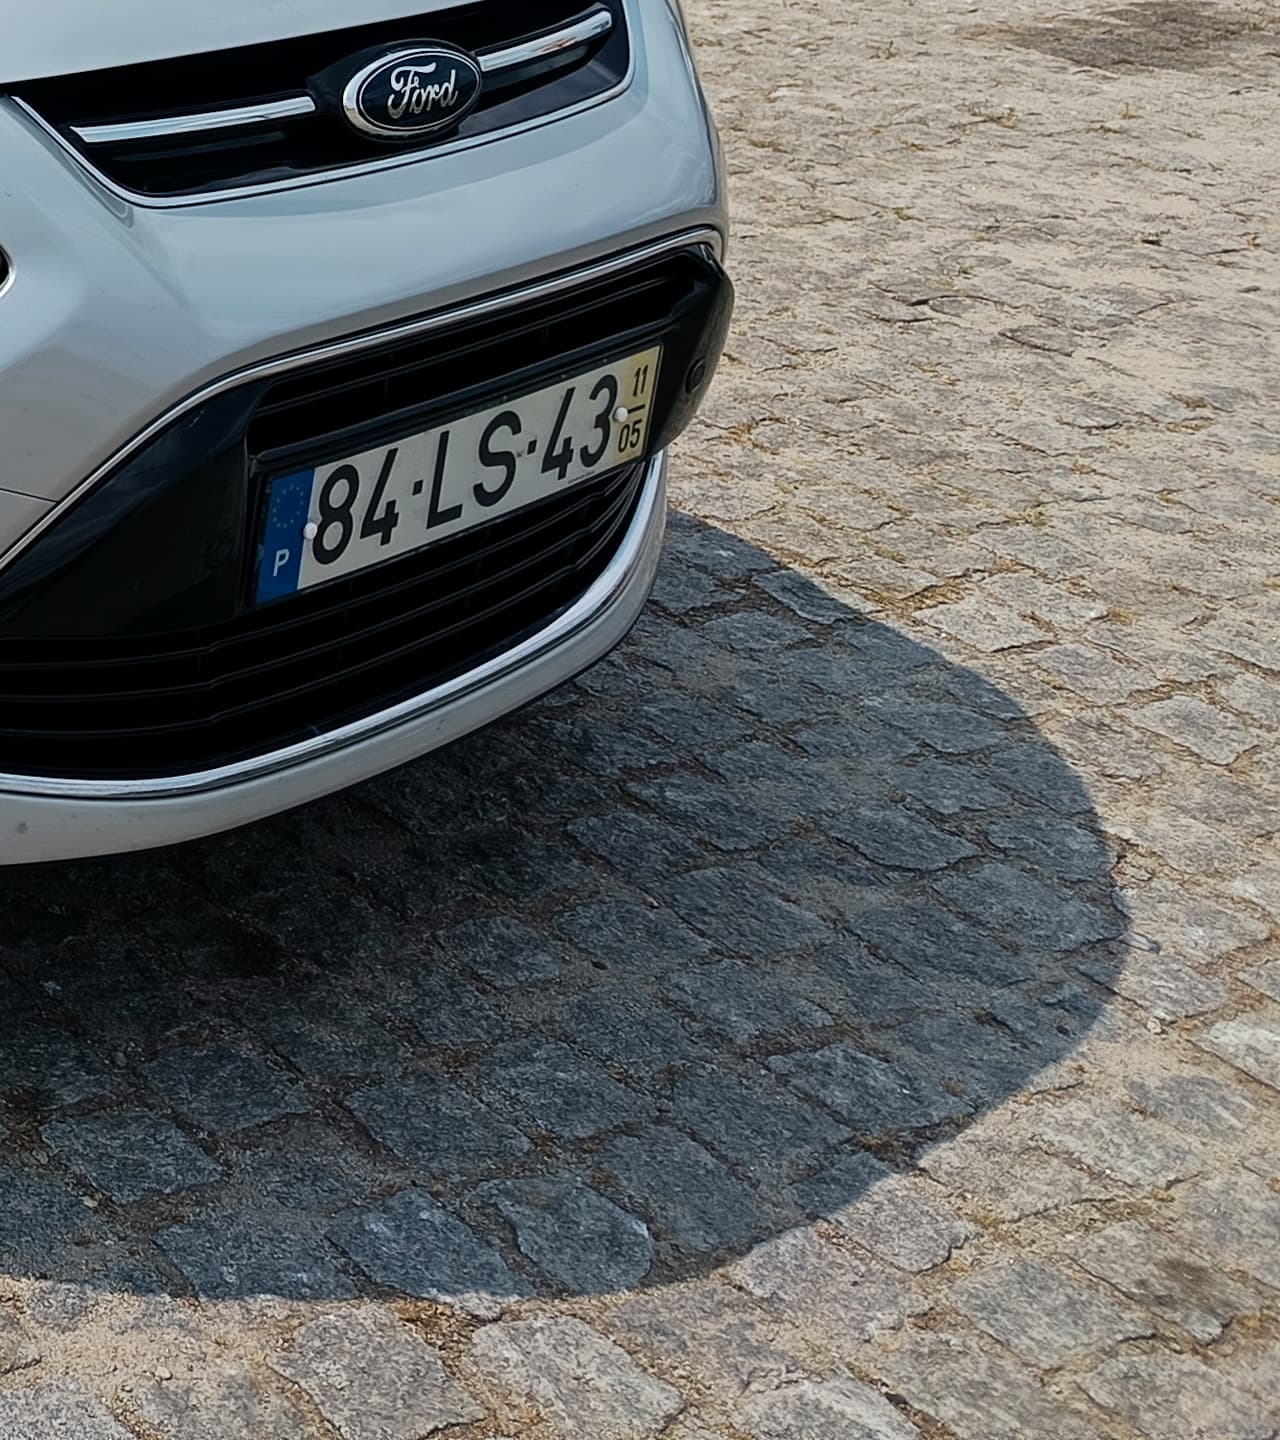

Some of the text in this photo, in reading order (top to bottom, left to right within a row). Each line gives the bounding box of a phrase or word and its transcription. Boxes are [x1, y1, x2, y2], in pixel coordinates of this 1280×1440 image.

[387, 62, 459, 119] Ford
[632, 365, 649, 397] 11
[618, 418, 643, 453] 05
[273, 548, 290, 577] P
